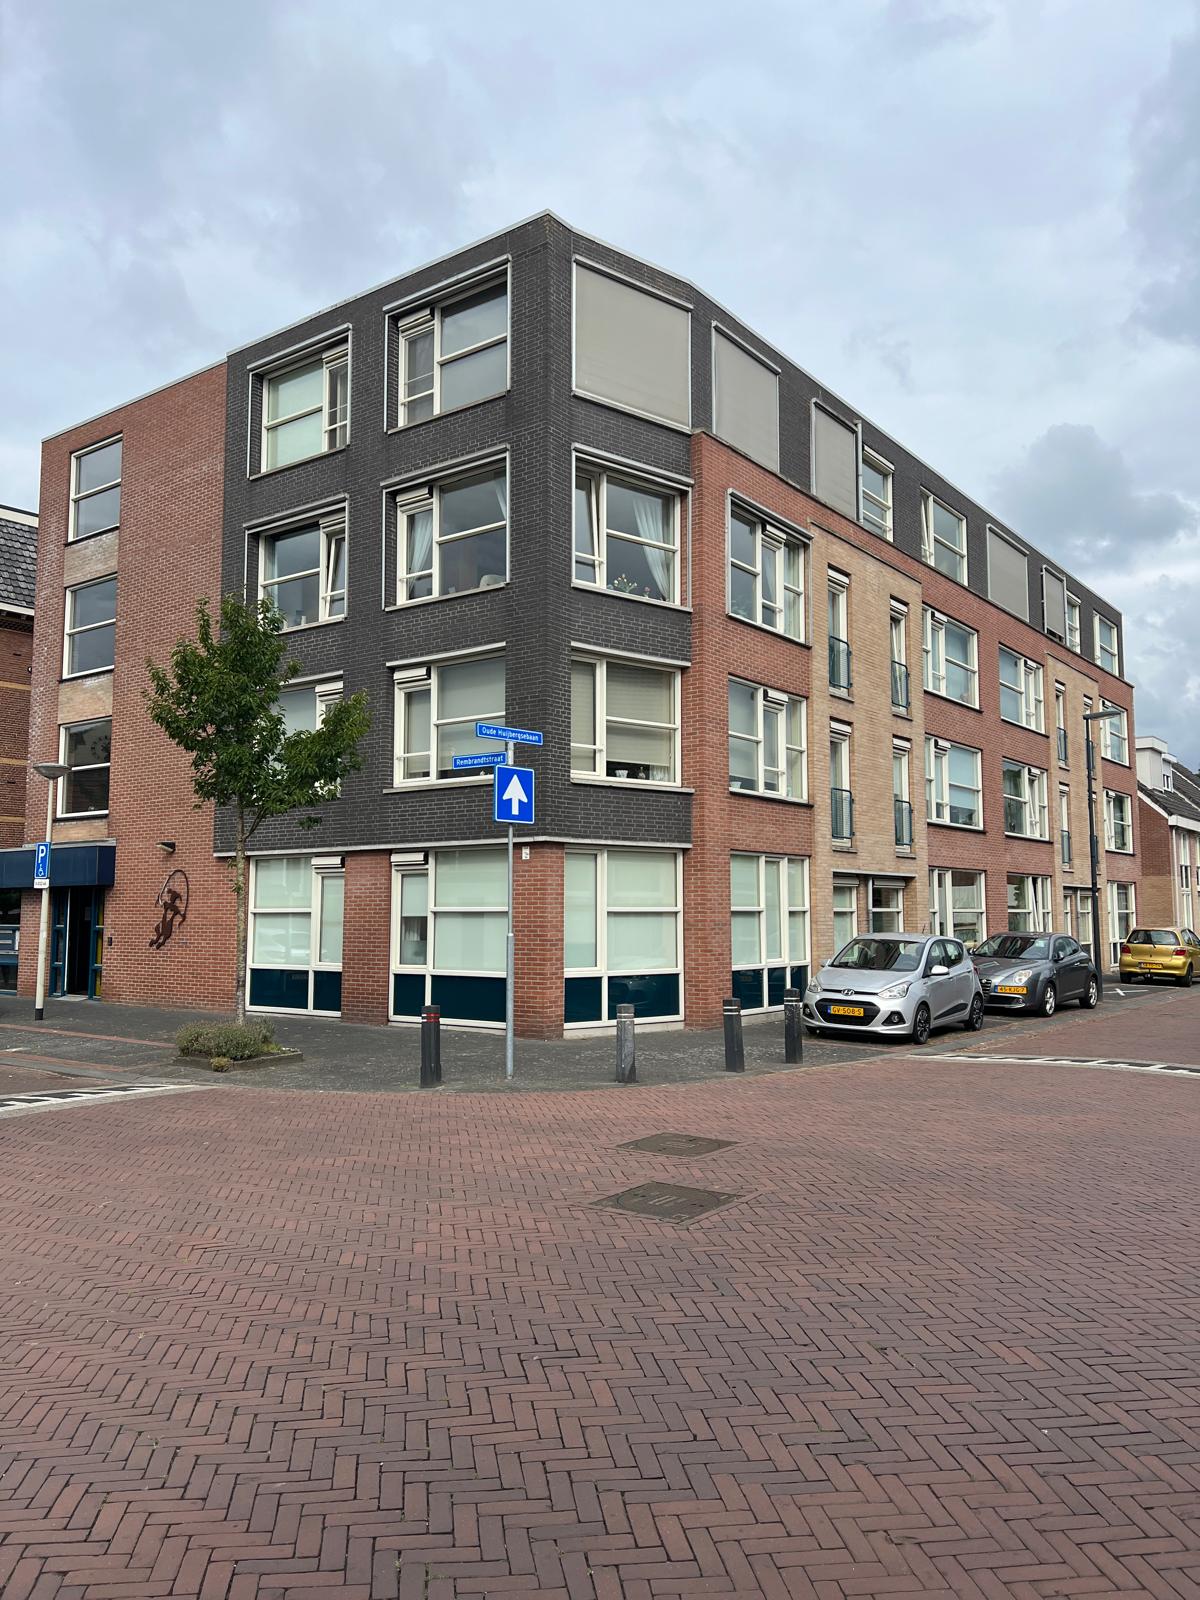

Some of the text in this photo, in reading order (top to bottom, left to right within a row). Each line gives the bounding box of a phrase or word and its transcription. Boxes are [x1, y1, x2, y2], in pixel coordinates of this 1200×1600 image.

[482, 726, 539, 741] Oude Huijbergsebaan
[456, 755, 504, 766] Rembrandtstraat
[38, 845, 46, 864] P
[832, 1006, 862, 1016] GV-508-S
